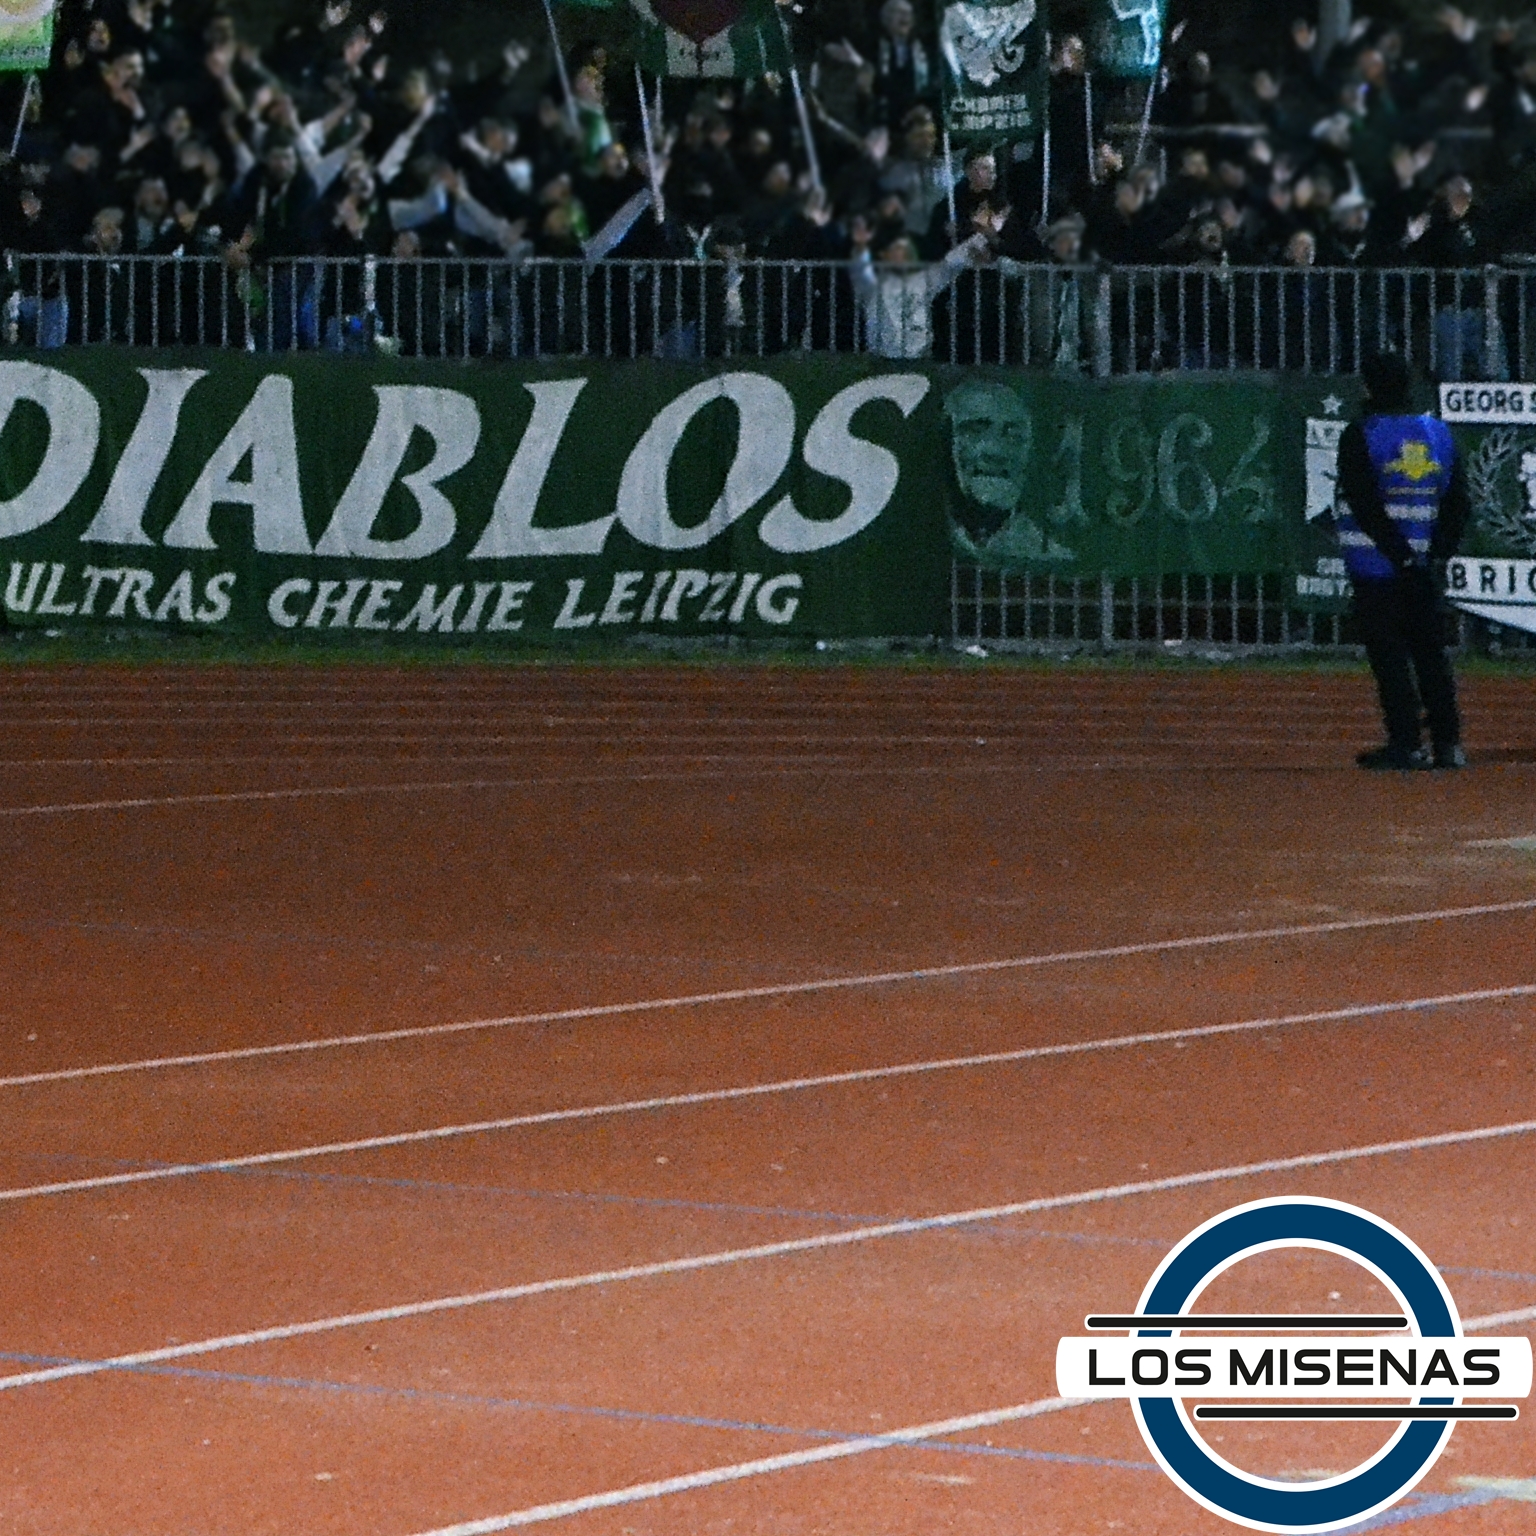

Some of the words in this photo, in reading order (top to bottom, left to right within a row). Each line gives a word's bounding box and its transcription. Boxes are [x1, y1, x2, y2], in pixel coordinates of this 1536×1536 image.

[1445, 390, 1524, 414] GEORG
[5, 559, 234, 623] ULTRAS
[269, 576, 535, 634] CHEMIE
[552, 565, 804, 631] LEIPZIG
